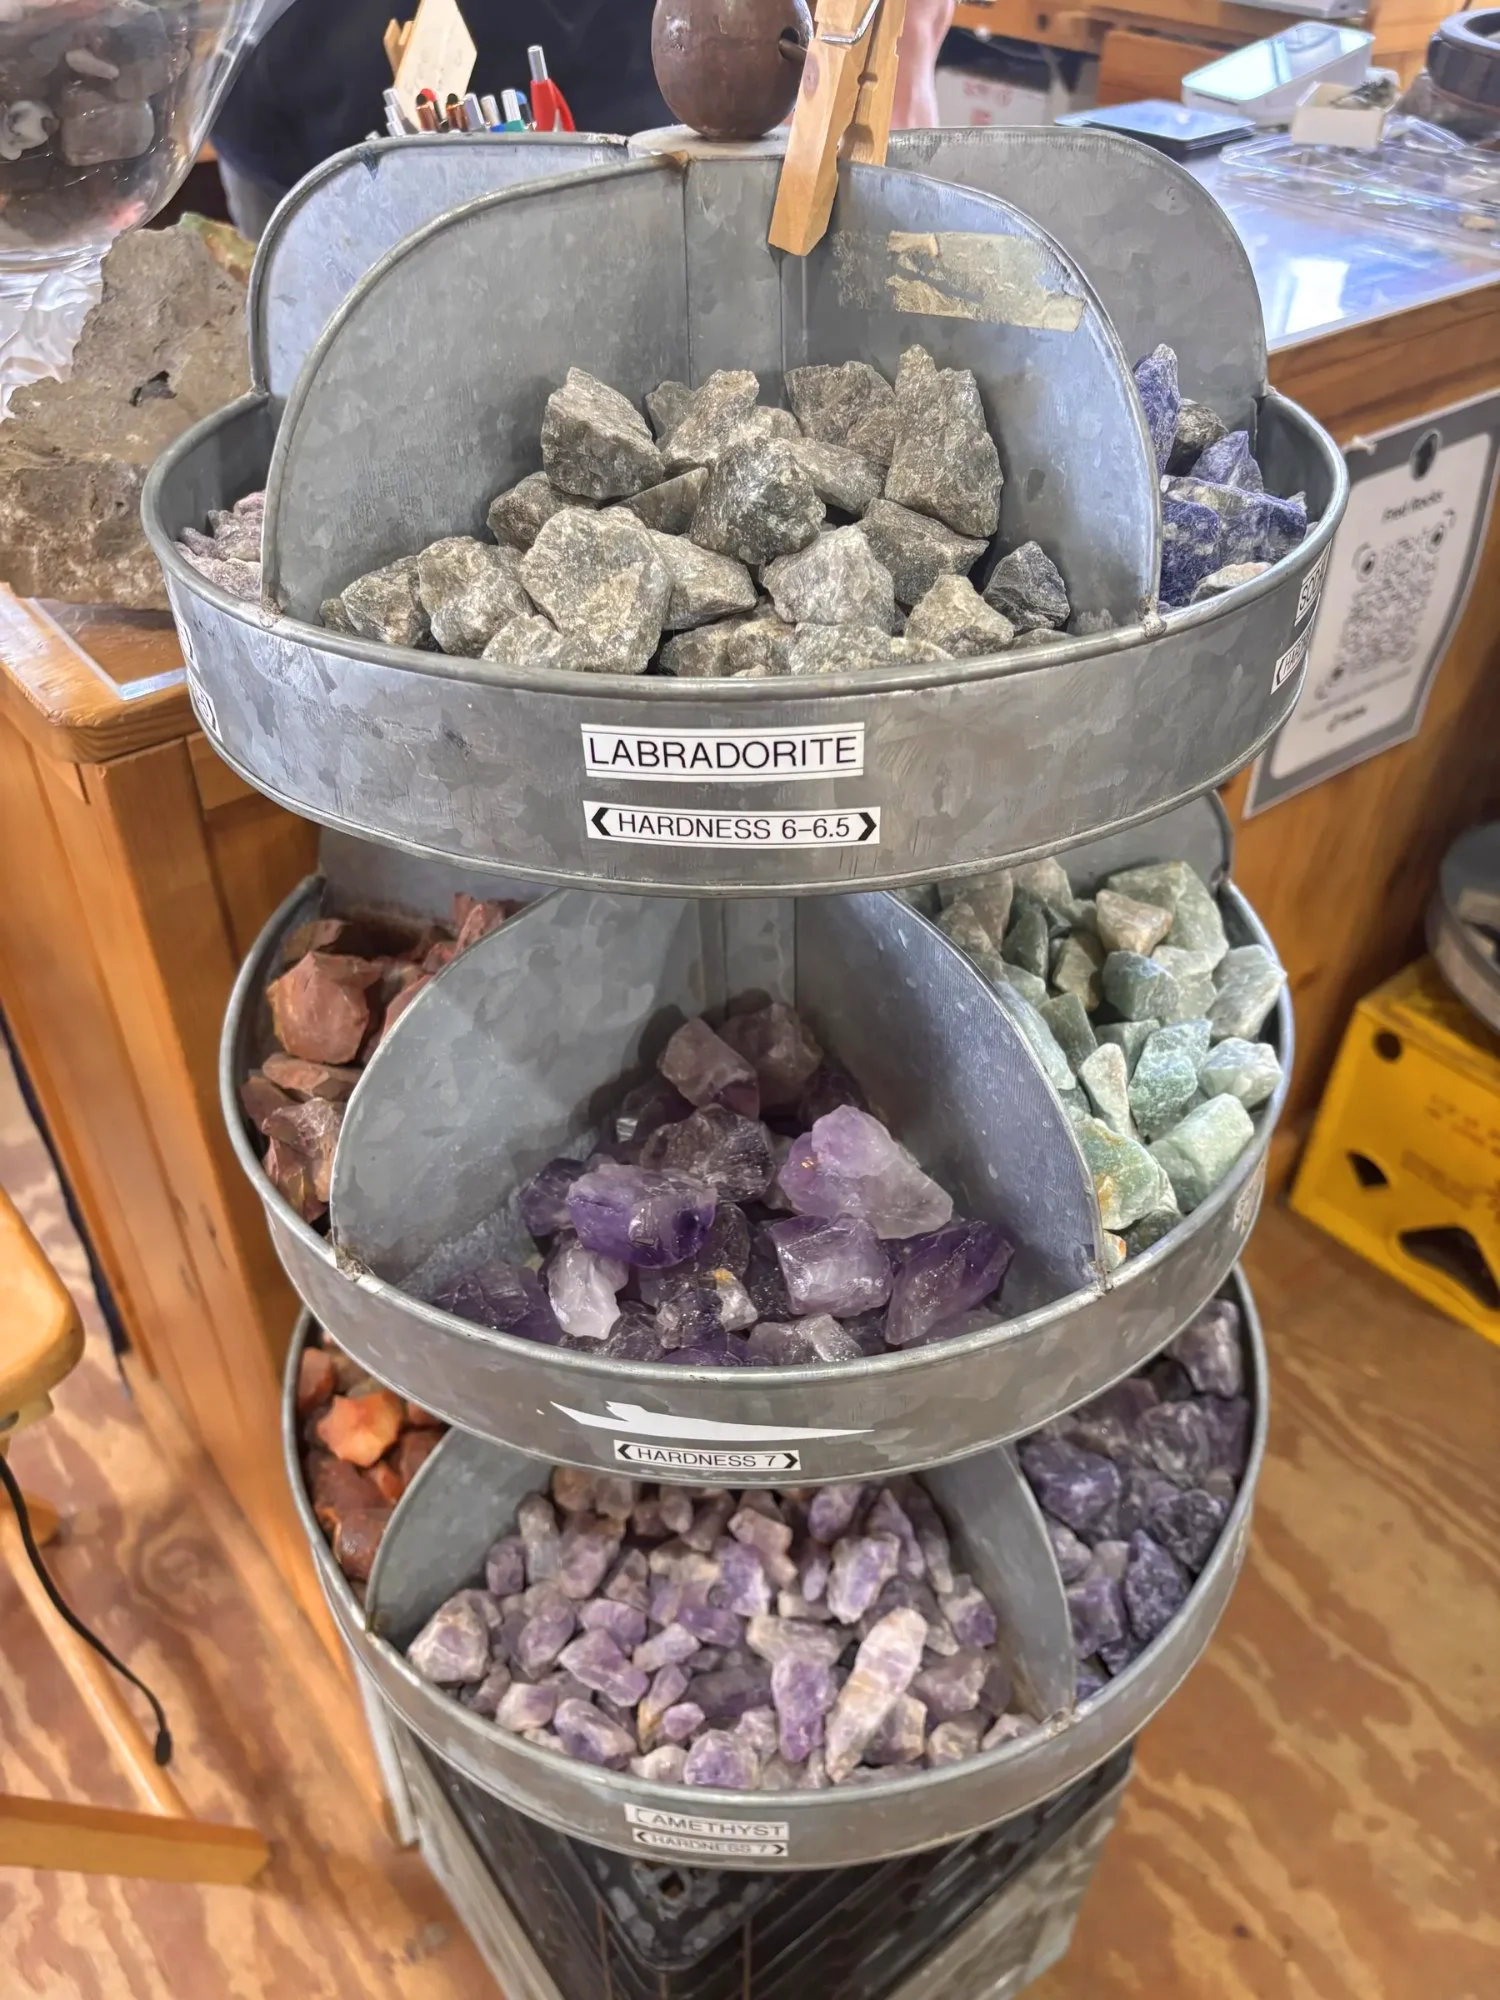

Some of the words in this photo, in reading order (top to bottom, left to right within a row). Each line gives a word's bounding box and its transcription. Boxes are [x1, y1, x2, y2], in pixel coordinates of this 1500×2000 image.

[589, 736, 857, 768] LABRADORITE
[618, 812, 771, 839] HARDNESS
[637, 1447, 757, 1468] HARDNESS
[764, 1455, 777, 1467] 7
[652, 1814, 785, 1837] AMETHYST
[652, 1833, 753, 1854] HARDNESS
